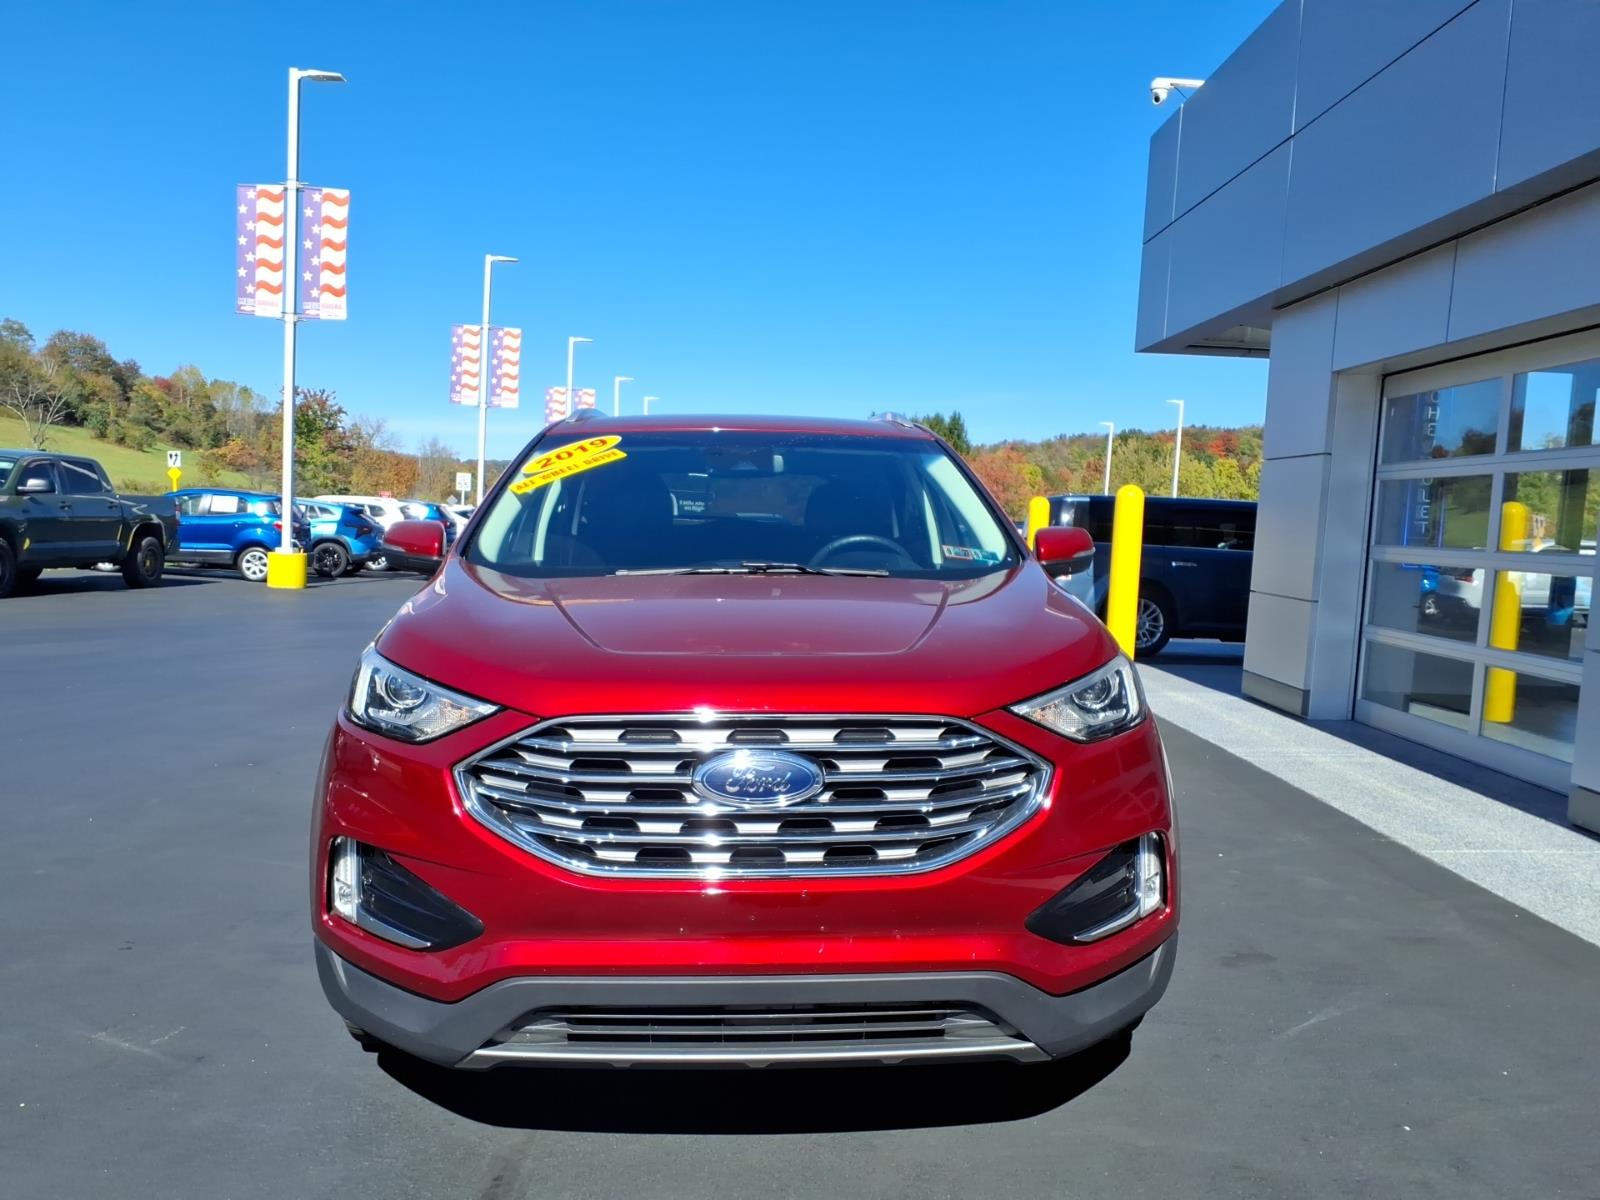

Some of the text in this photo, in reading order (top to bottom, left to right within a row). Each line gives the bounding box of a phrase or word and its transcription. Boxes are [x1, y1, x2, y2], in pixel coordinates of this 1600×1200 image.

[536, 438, 608, 469] 2019
[516, 451, 618, 491] ALL WHEEL DRIVE
[725, 764, 792, 793] Ford
